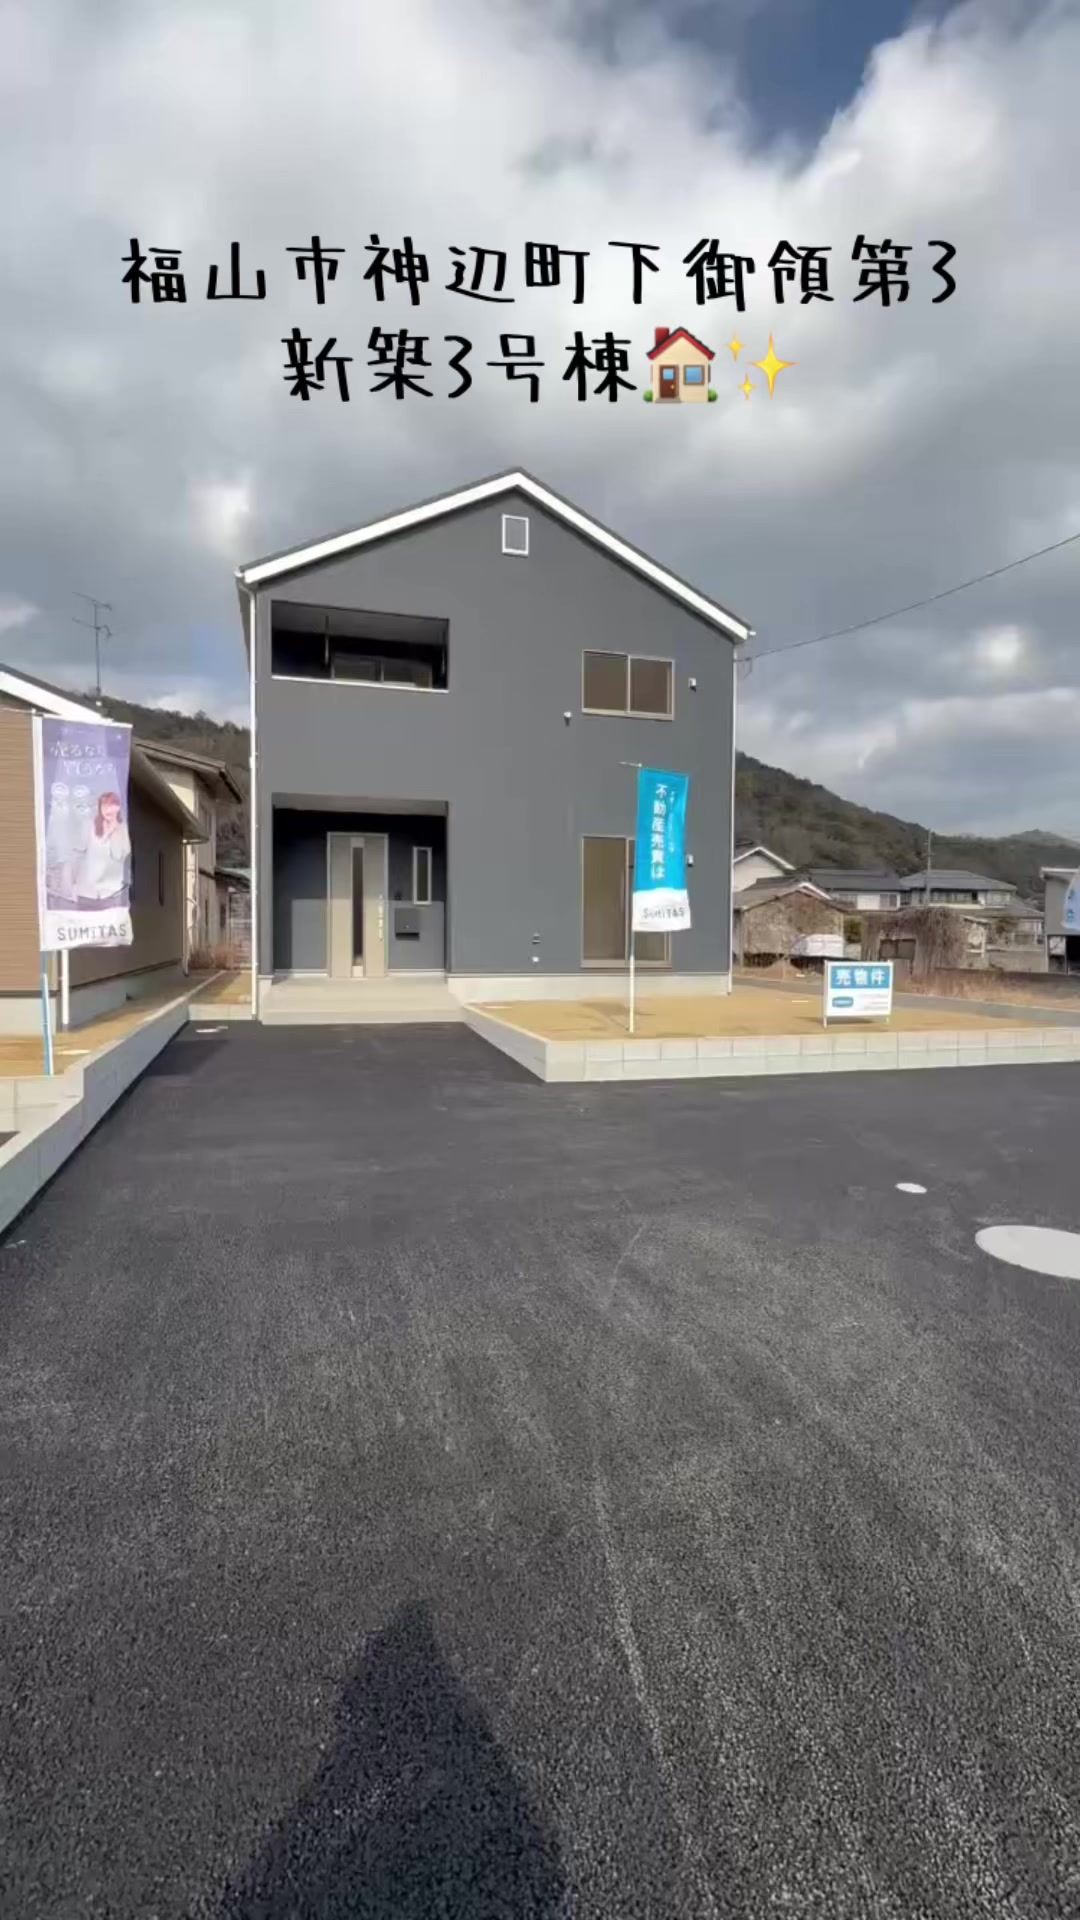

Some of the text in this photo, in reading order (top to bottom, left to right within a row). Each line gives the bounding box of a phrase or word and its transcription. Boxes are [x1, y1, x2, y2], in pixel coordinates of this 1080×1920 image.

[651, 783, 668, 881] 不動産売買は
[642, 906, 685, 919] SUMITAS
[56, 923, 127, 942] SUMITAS
[835, 967, 885, 986] 売物件
